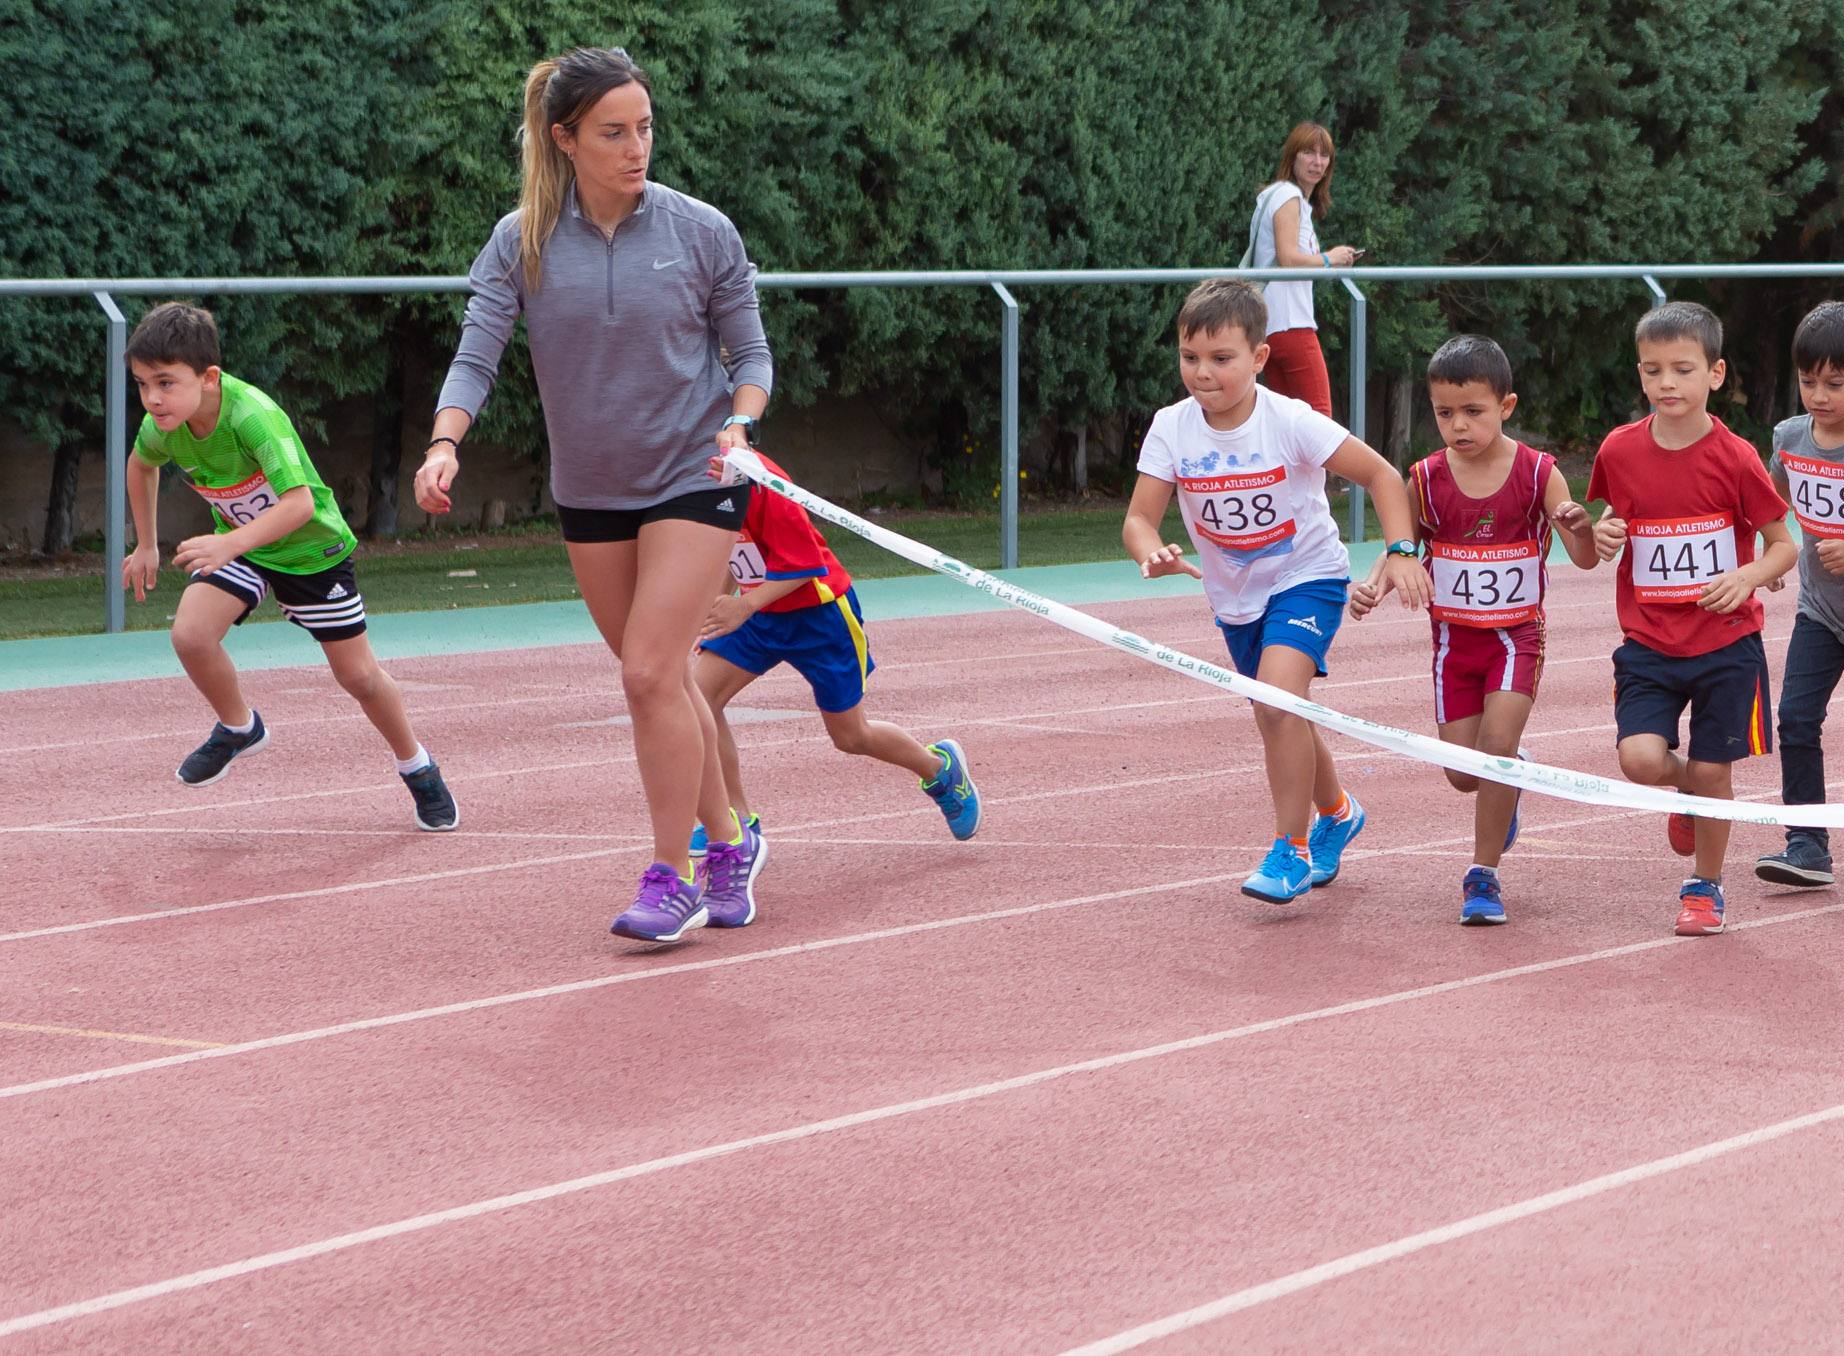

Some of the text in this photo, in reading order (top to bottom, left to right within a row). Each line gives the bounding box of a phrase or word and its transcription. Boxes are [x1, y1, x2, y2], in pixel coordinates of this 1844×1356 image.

[1793, 461, 1818, 473] RIOJA
[1192, 481, 1221, 491] RIOJA
[1224, 475, 1275, 490] ATLETISMO
[1201, 493, 1277, 531] 438
[1637, 518, 1725, 535] LA RIOJA ATLETISMO
[1442, 547, 1528, 560] LA RIOJA ATLETISMO
[1648, 539, 1725, 581] 441
[1451, 567, 1526, 606] 432
[995, 587, 1012, 600] La
[1016, 598, 1050, 616] Rioja
[1442, 610, 1529, 622] www.lariojaatletismo.com
[1178, 657, 1194, 670] La
[1198, 664, 1232, 683] Rioja
